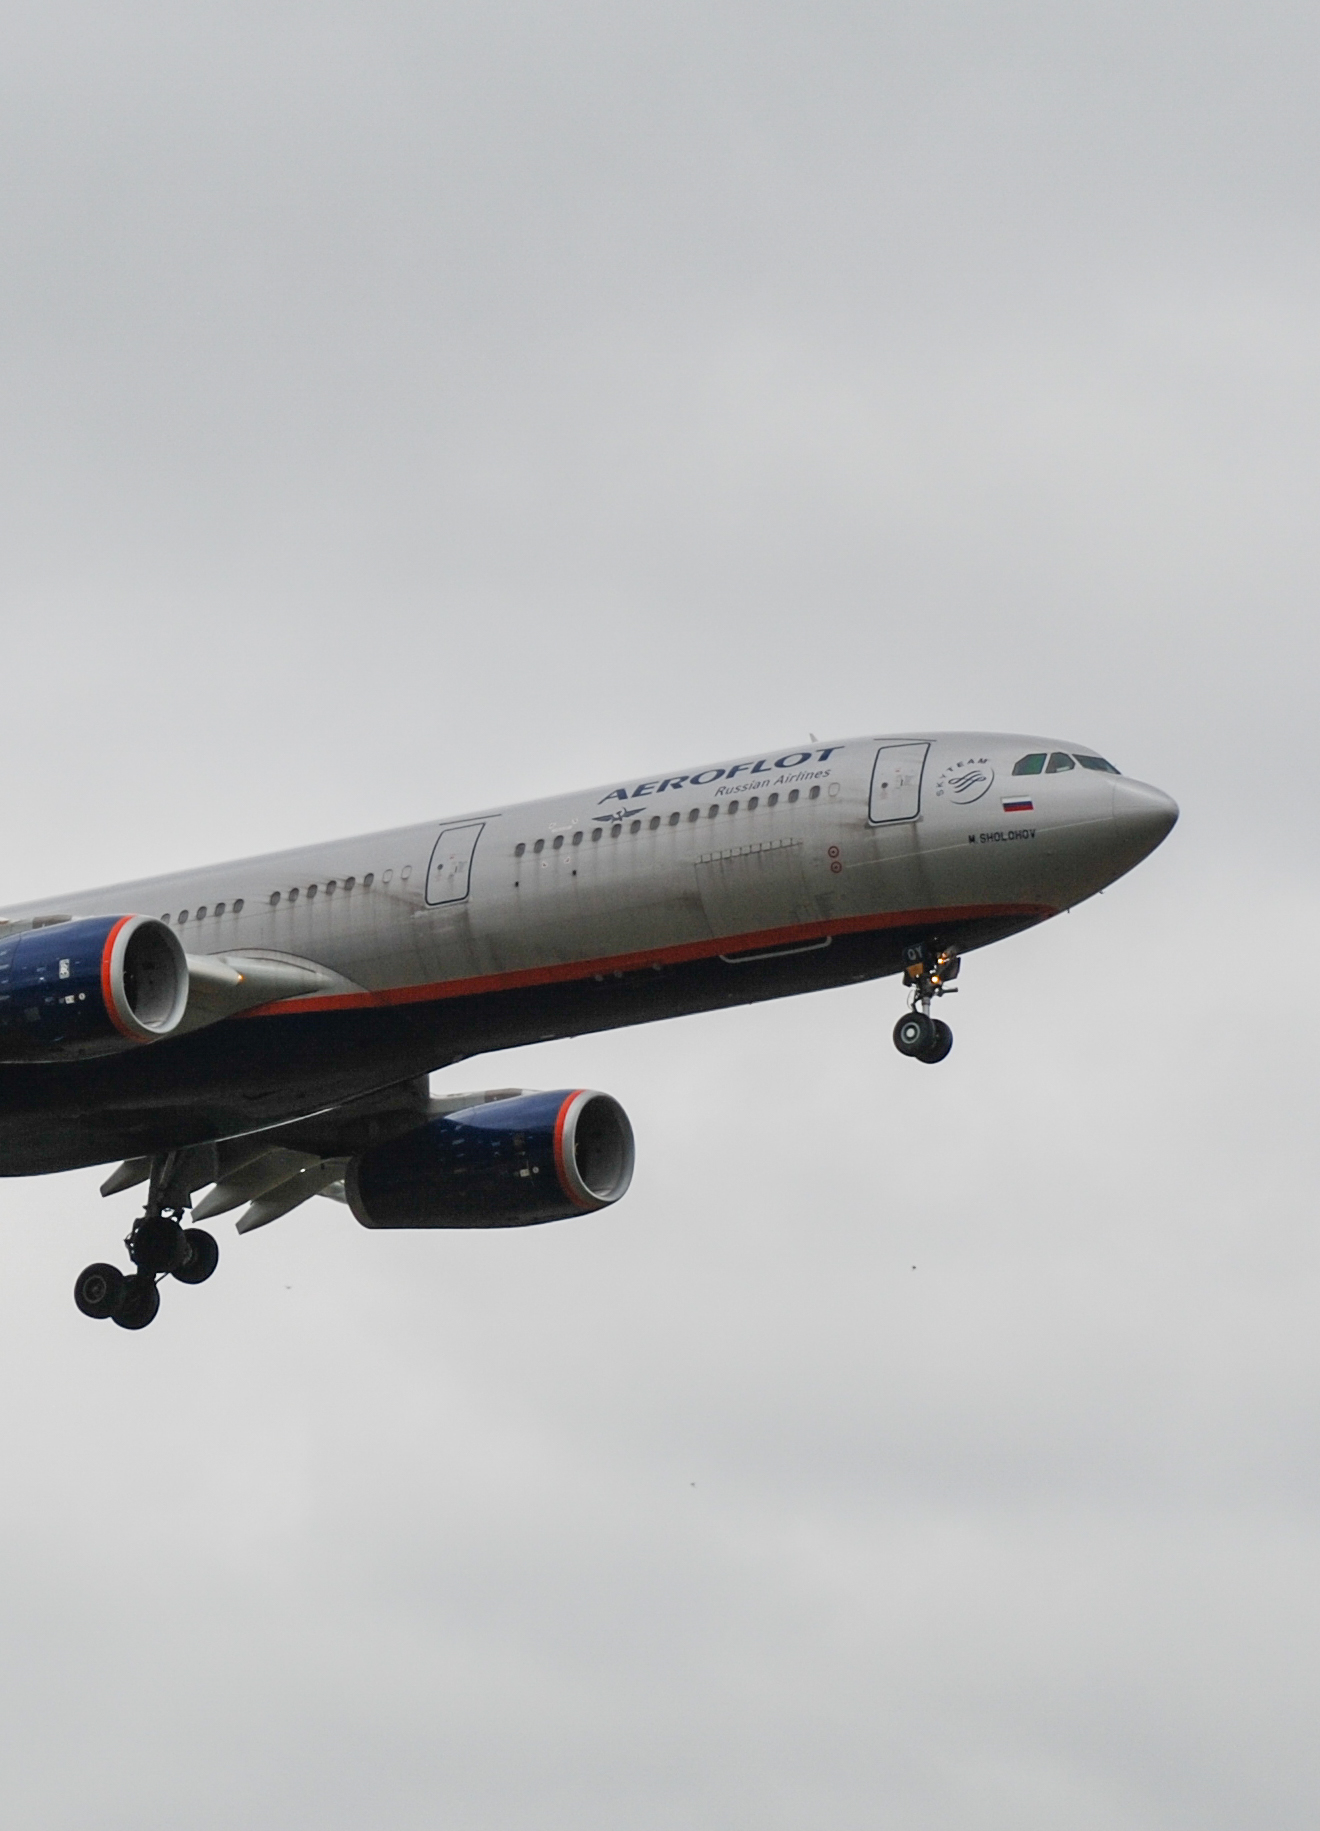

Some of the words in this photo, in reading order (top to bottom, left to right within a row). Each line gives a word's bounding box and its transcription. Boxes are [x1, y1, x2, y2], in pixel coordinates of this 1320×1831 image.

[597, 745, 846, 805] AEROFLOT
[714, 779, 770, 797] Russian
[773, 768, 832, 786] Airlines
[936, 757, 989, 797] SKYTEAM
